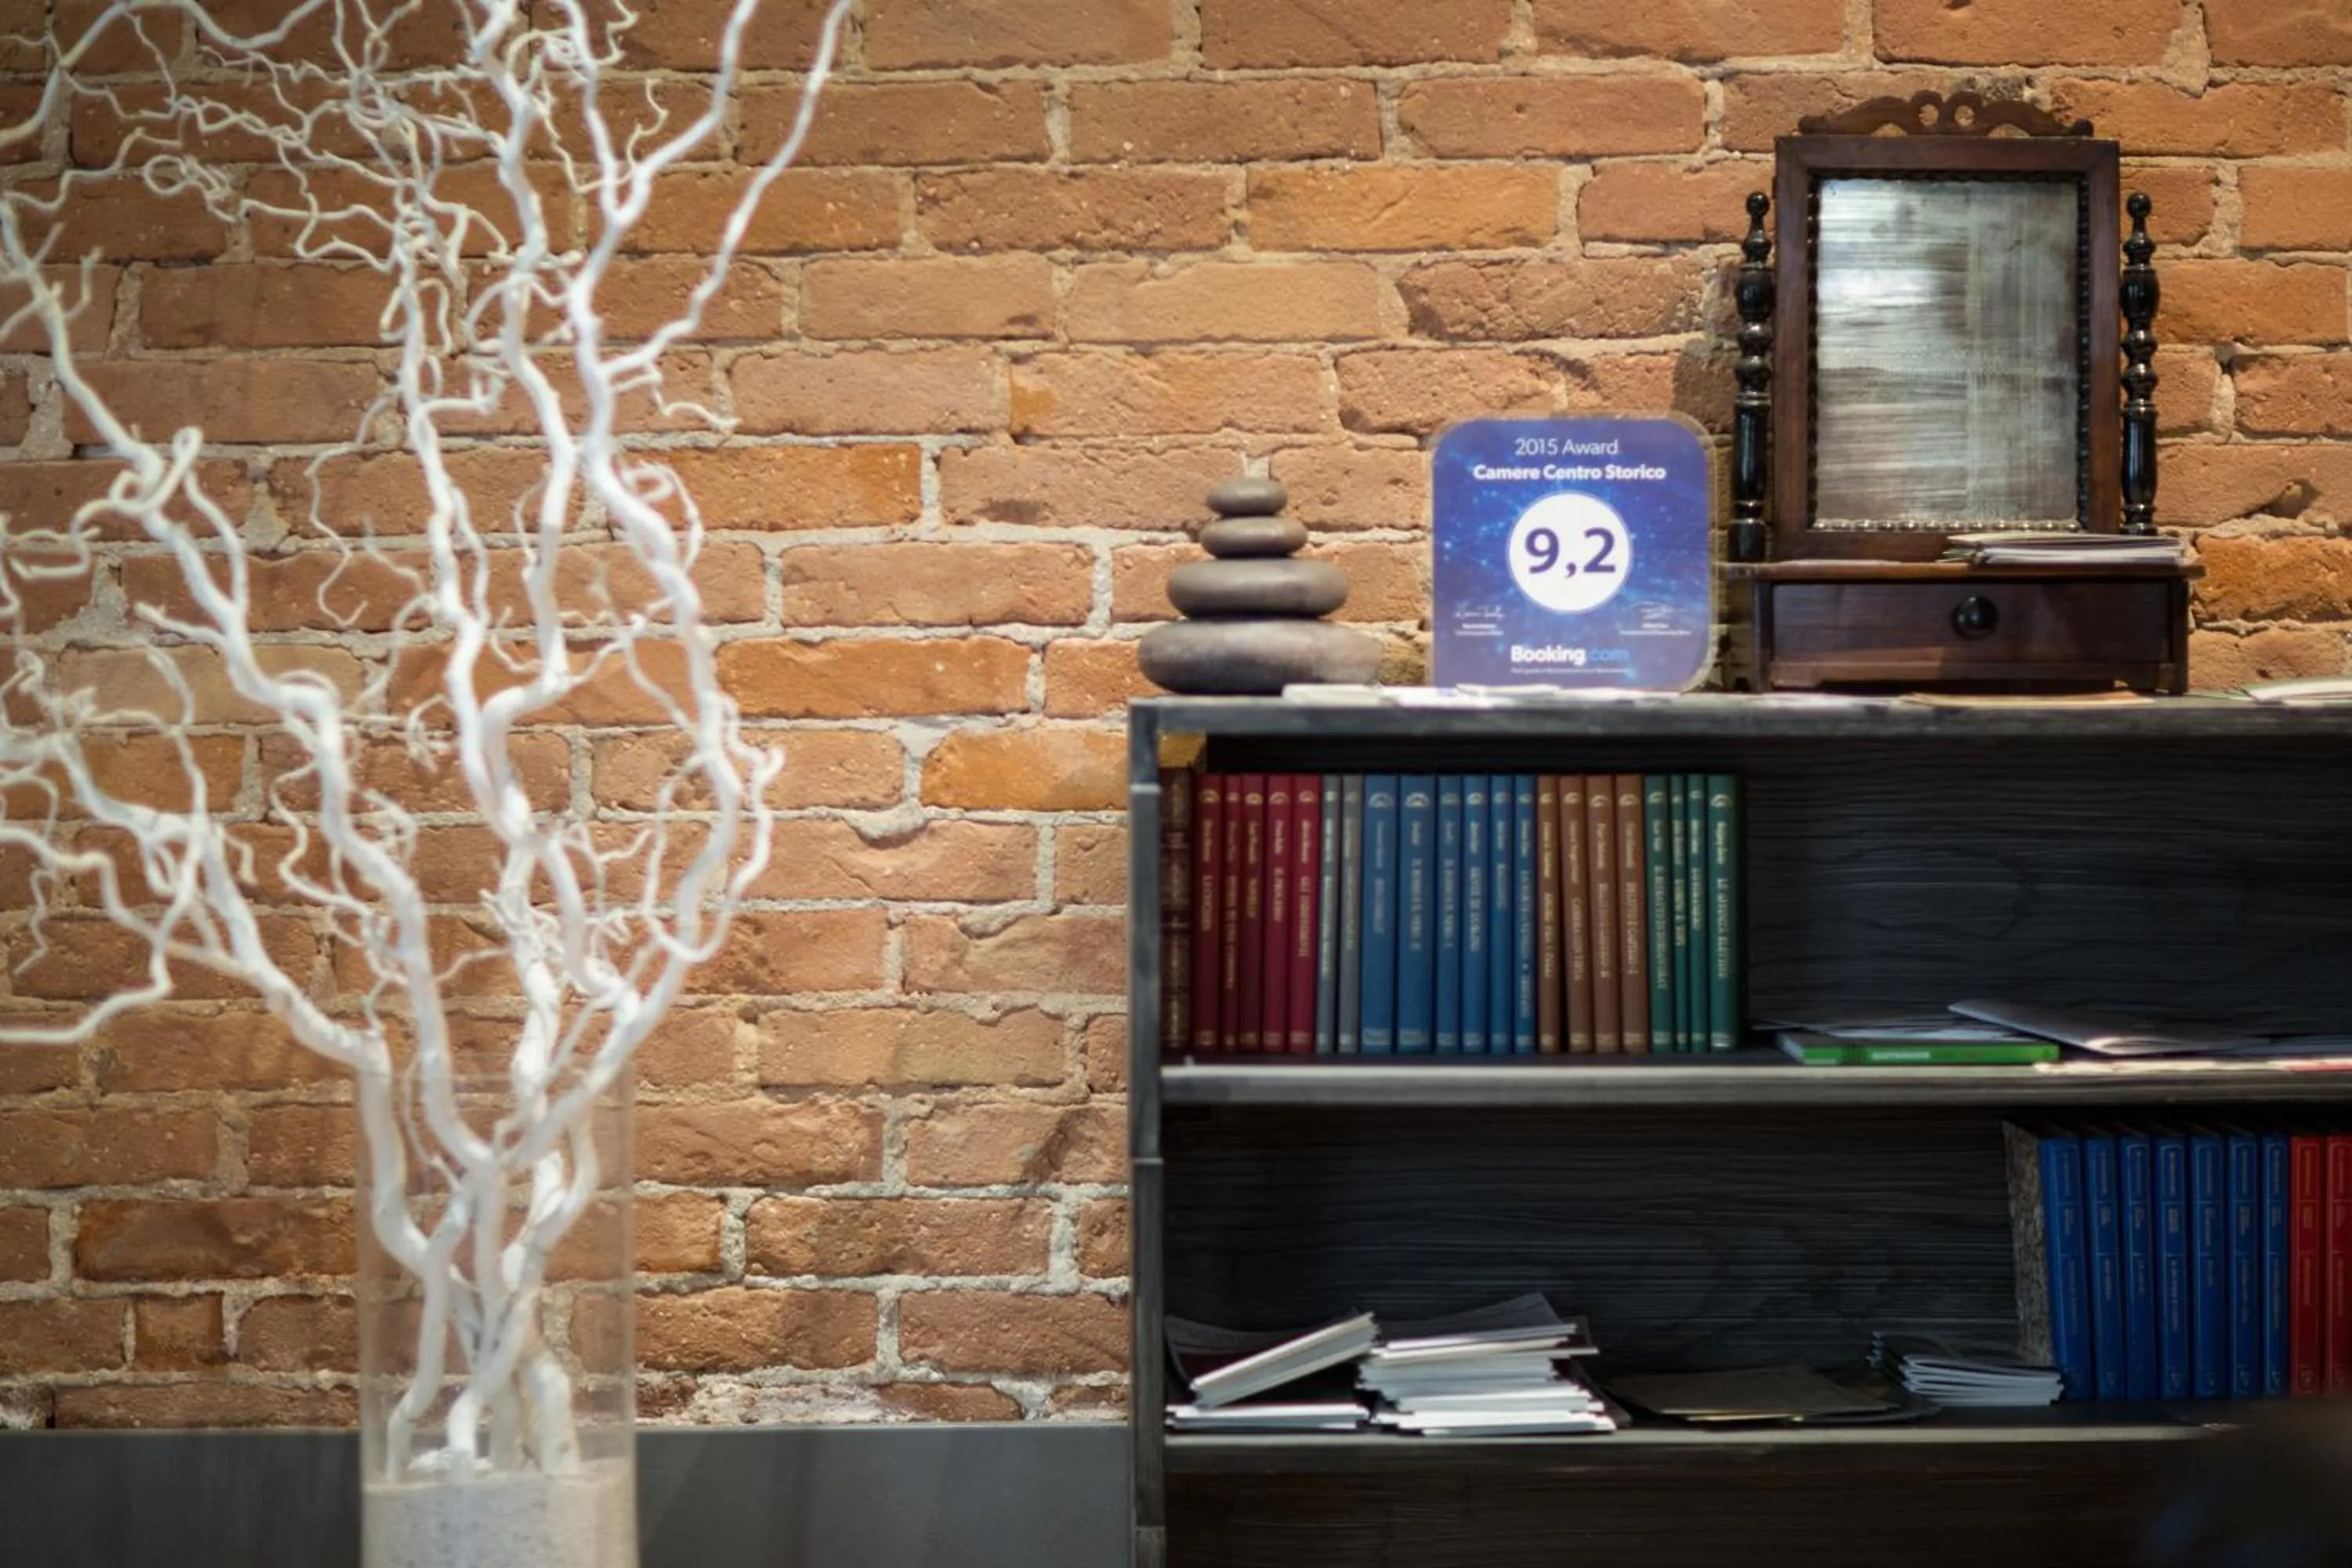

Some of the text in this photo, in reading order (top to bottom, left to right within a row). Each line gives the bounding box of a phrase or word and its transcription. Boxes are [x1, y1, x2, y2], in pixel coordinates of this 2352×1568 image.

[1515, 438, 1619, 456] 2015 Award
[1473, 463, 1667, 481] Camere Centro Storico
[1525, 527, 1617, 579] 9,2
